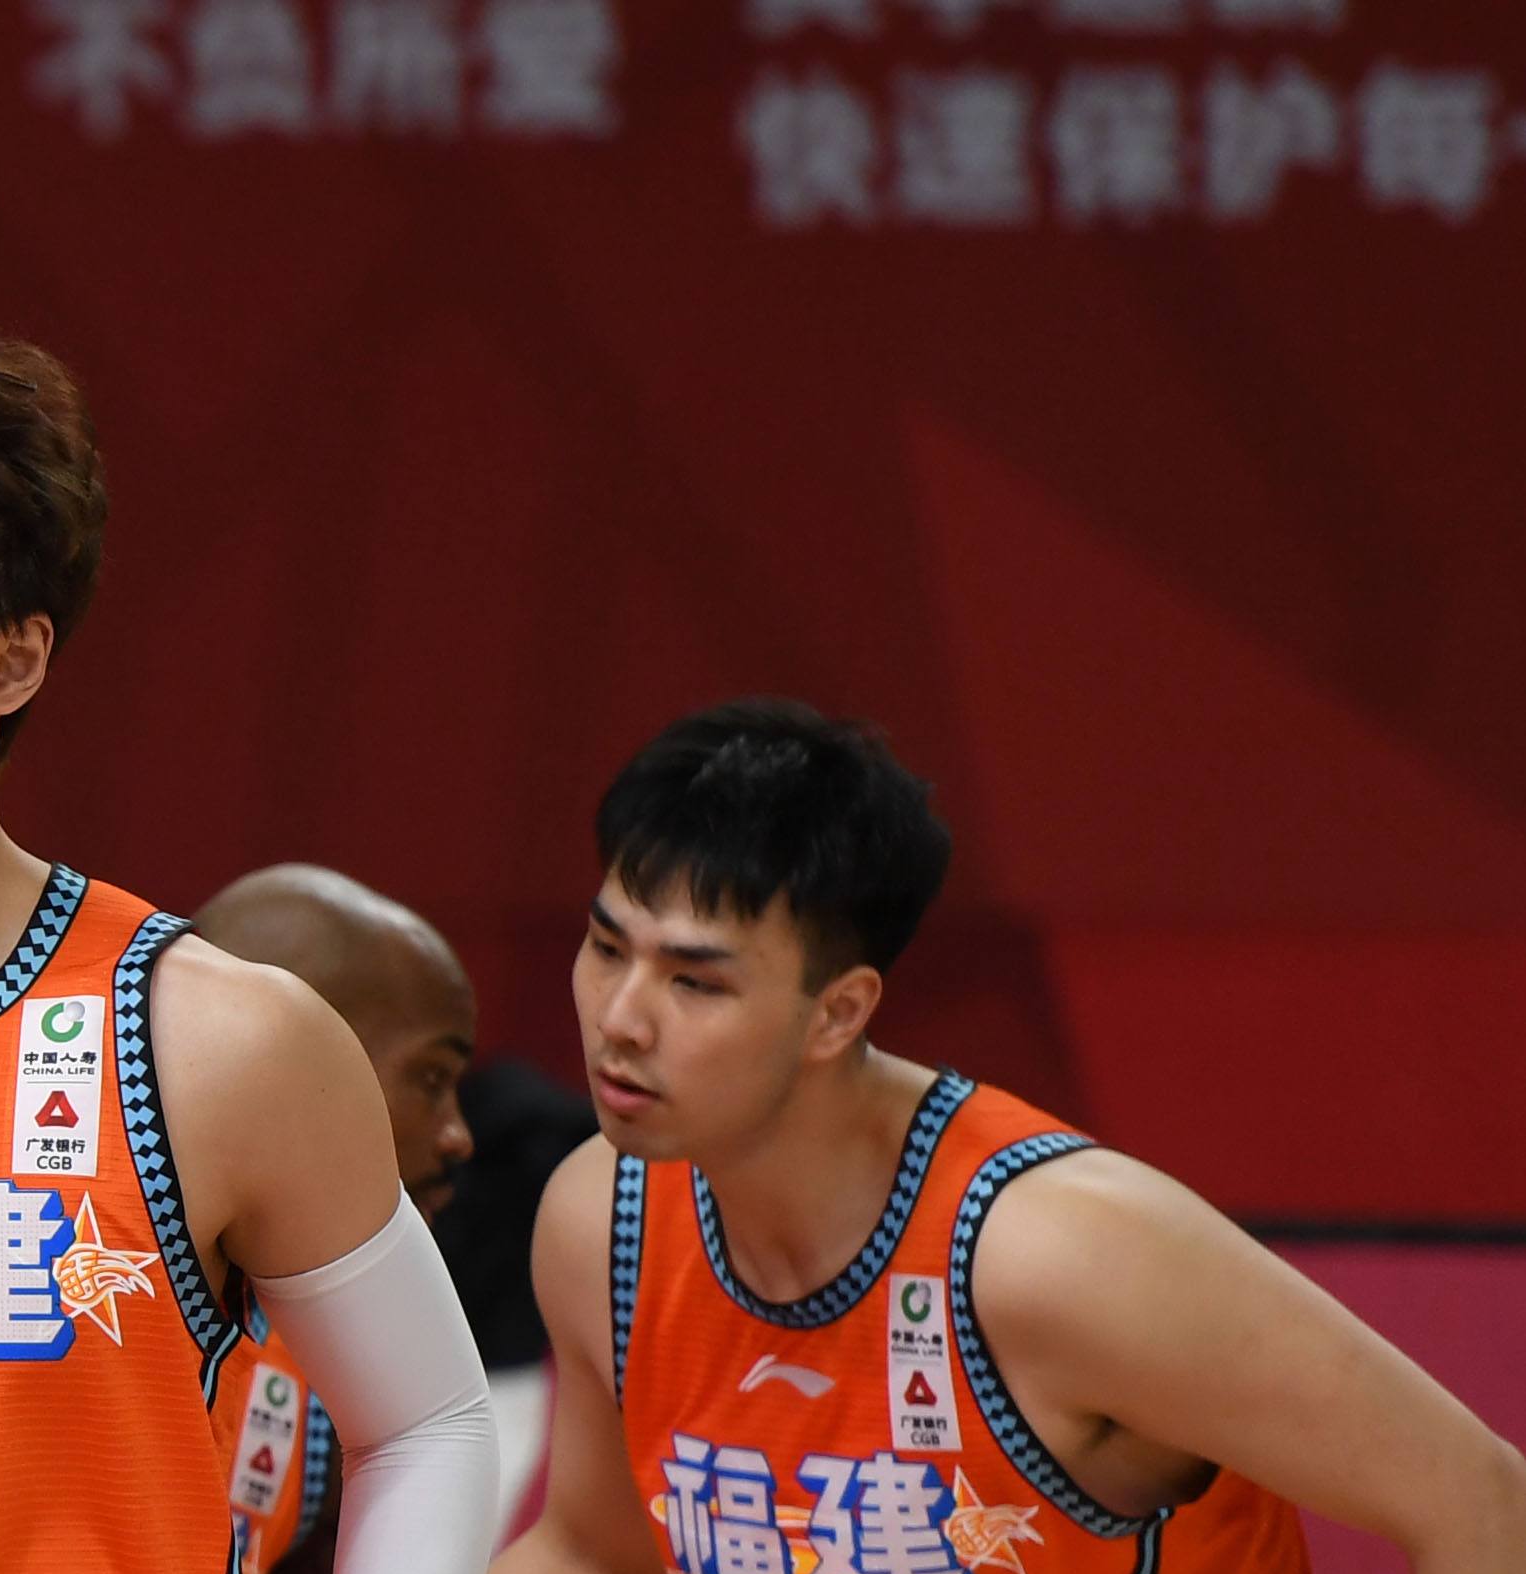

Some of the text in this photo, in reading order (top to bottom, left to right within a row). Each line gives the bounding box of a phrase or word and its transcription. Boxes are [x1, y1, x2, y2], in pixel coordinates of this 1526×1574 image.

[738, 62, 1526, 225] 快速保护每
[24, 1051, 97, 1065] 中国人寿
[23, 1067, 95, 1075] CHINA LIFE
[25, 1138, 86, 1154] 广发银行
[36, 1155, 73, 1170] CGB
